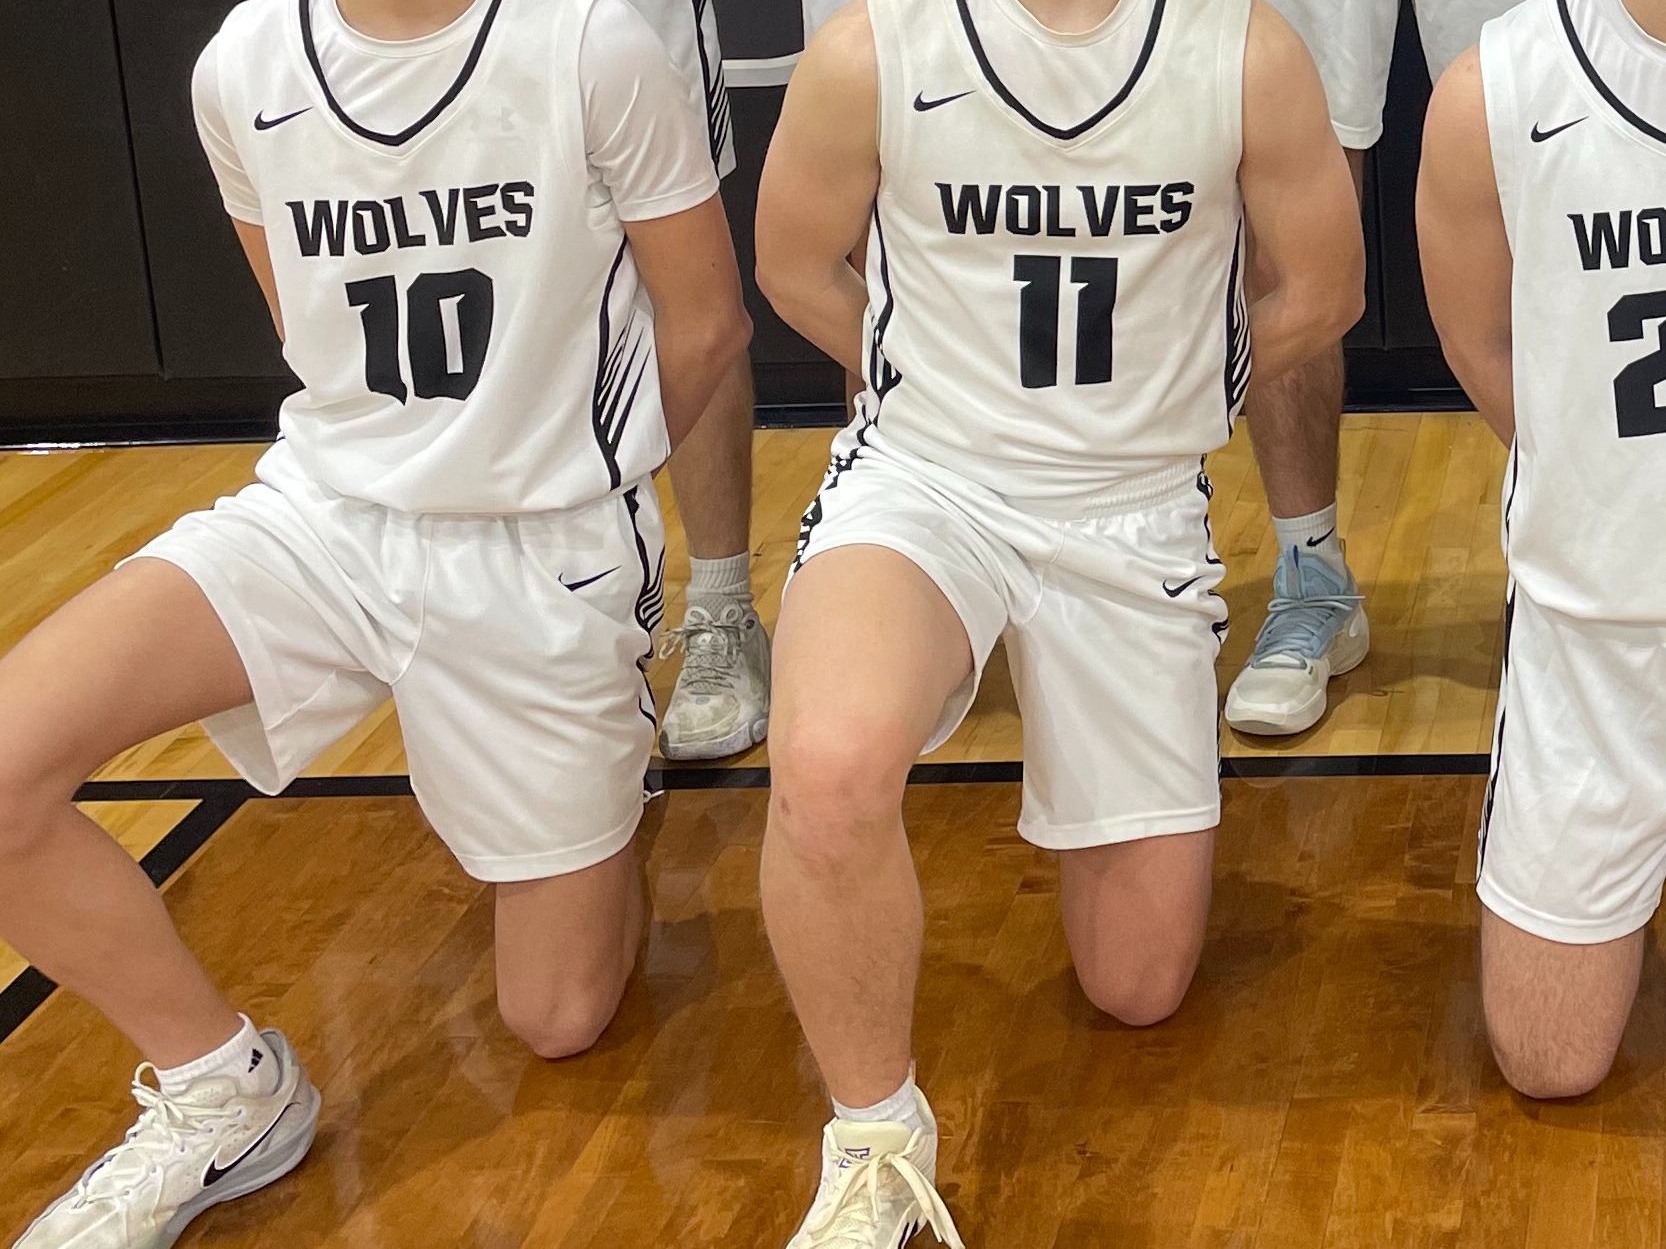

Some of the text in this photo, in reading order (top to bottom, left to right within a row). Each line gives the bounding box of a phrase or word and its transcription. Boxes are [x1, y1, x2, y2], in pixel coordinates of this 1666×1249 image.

[286, 181, 534, 257] WOLVES
[935, 182, 1194, 237] WOLVES
[345, 269, 493, 405] 10
[1013, 255, 1118, 388] 11
